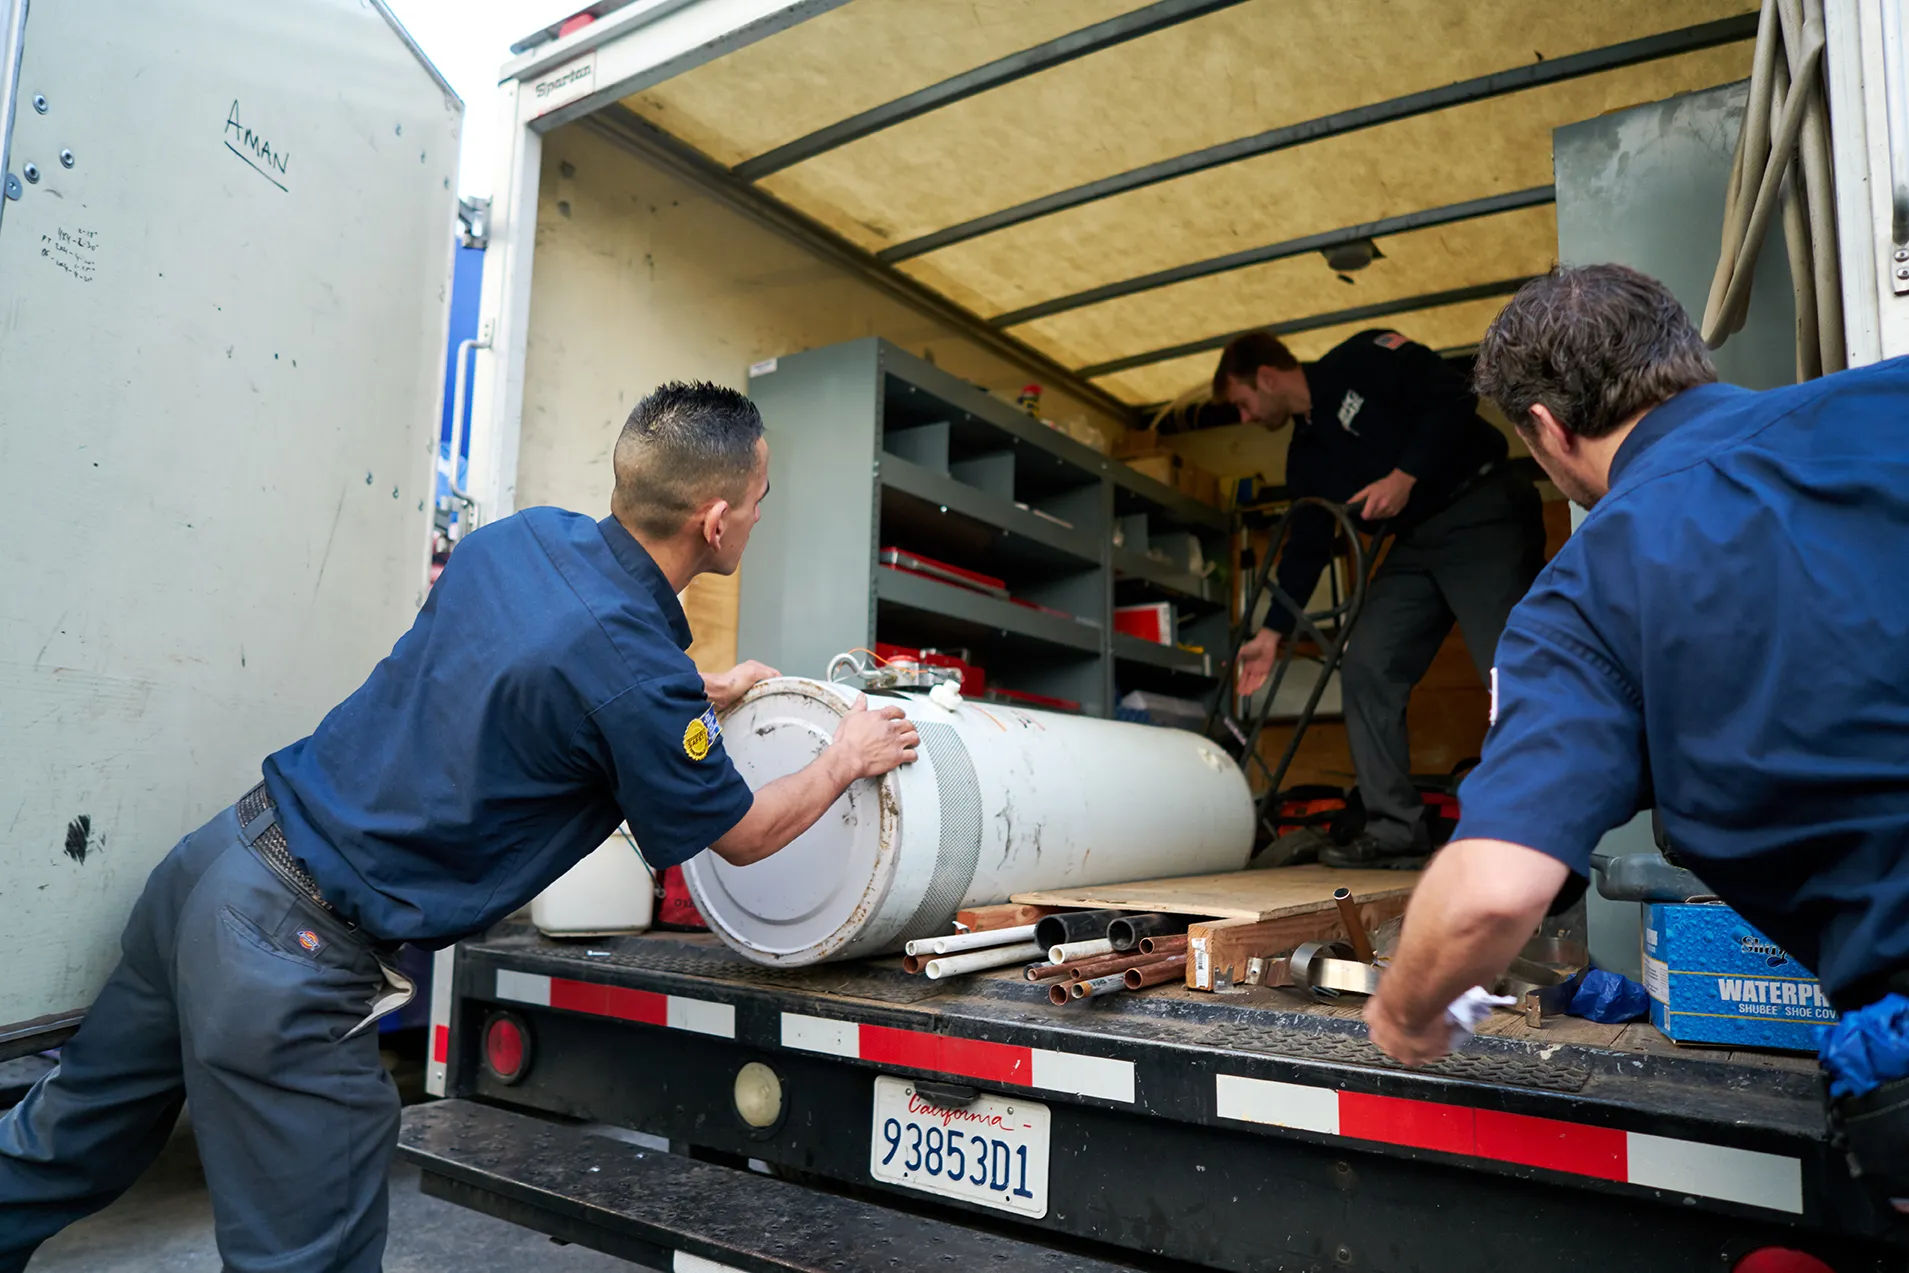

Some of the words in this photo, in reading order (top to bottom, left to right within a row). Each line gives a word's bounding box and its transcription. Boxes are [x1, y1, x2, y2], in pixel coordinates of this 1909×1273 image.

[535, 64, 591, 98] Spartan
[224, 98, 290, 174] AMAN
[1738, 1003, 1779, 1016] SHUBEE
[1785, 1006, 1813, 1018] SHOE
[881, 1117, 1034, 1200] 93853D1
